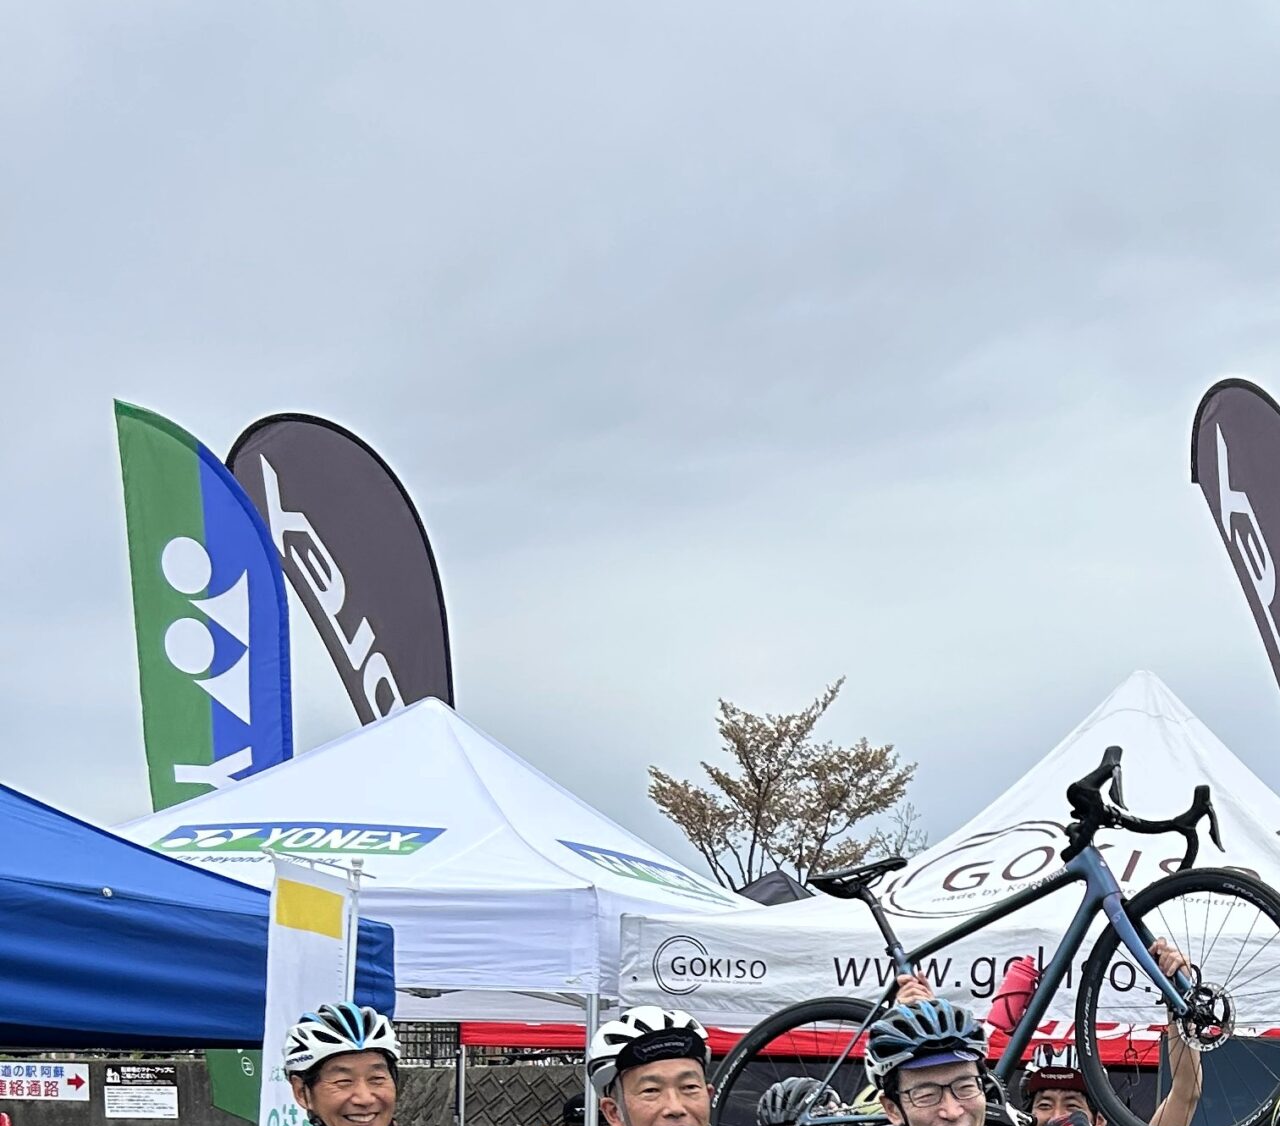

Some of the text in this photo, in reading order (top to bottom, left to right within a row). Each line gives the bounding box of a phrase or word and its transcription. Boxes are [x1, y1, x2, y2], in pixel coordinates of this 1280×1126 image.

[262, 827, 420, 850] YONEX
[671, 956, 767, 979] GOKISO
[1, 1065, 37, 1078] 道の駅
